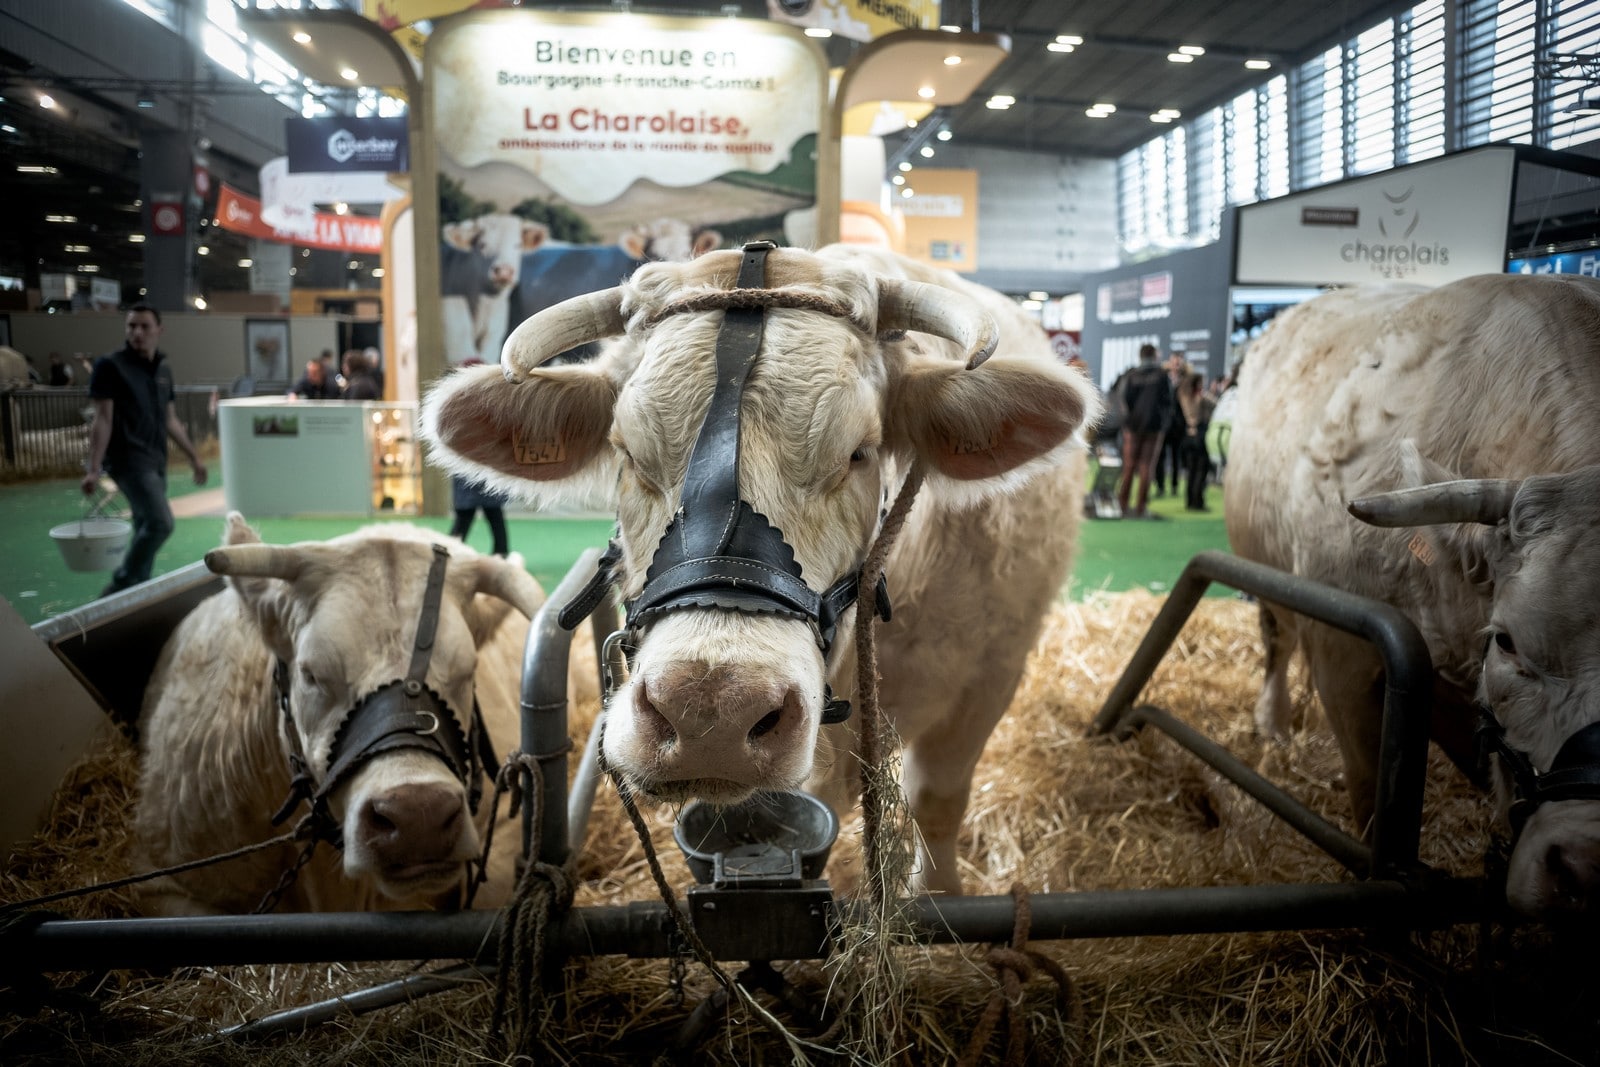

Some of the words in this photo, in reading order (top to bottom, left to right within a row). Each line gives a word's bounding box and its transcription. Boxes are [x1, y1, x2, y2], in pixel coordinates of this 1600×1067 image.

[535, 40, 693, 67] Bienvenue
[703, 50, 737, 67] en
[523, 107, 559, 131] La
[569, 108, 750, 137] Charolaise,
[1340, 237, 1450, 266] charolais
